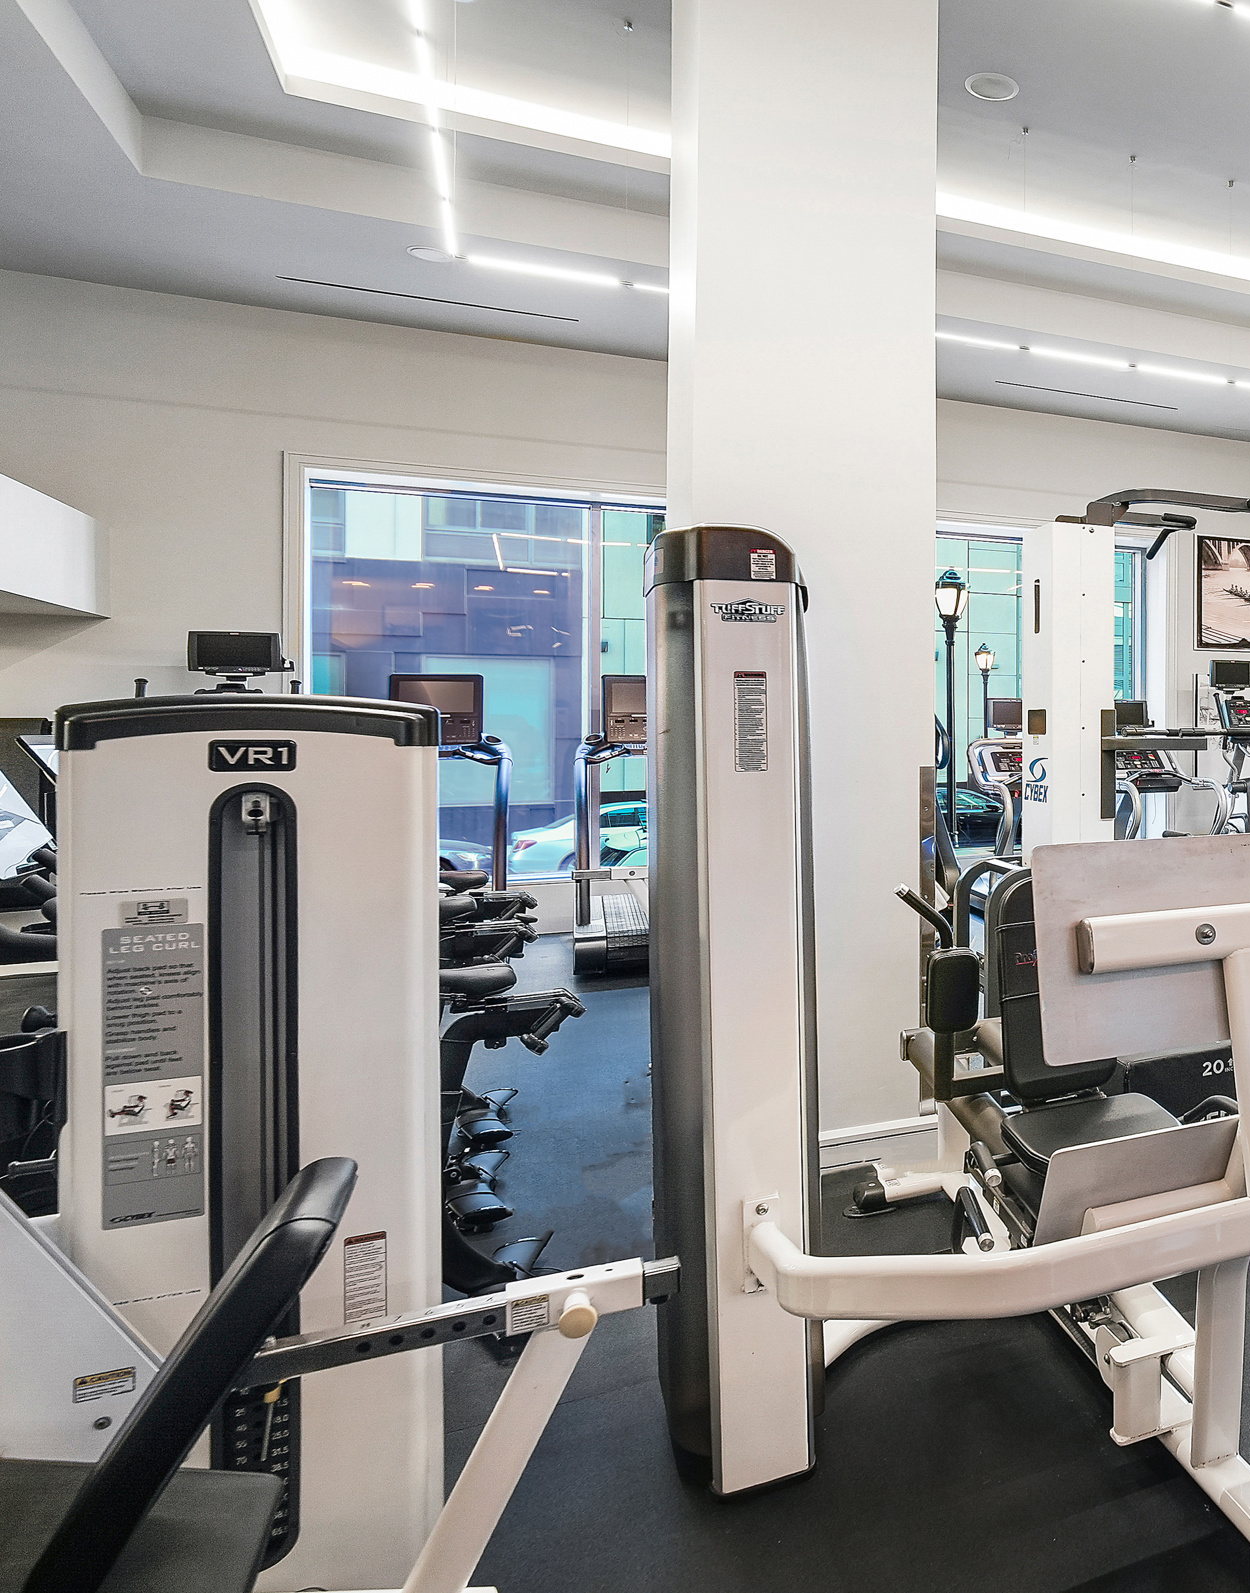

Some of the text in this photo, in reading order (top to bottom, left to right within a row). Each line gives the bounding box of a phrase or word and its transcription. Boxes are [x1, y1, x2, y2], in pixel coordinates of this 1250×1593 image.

[218, 747, 288, 765] VR1
[1024, 783, 1049, 803] CYBEX
[120, 932, 190, 944] SEATED
[109, 941, 200, 954] LEG CURL
[1202, 1059, 1225, 1077] 20
